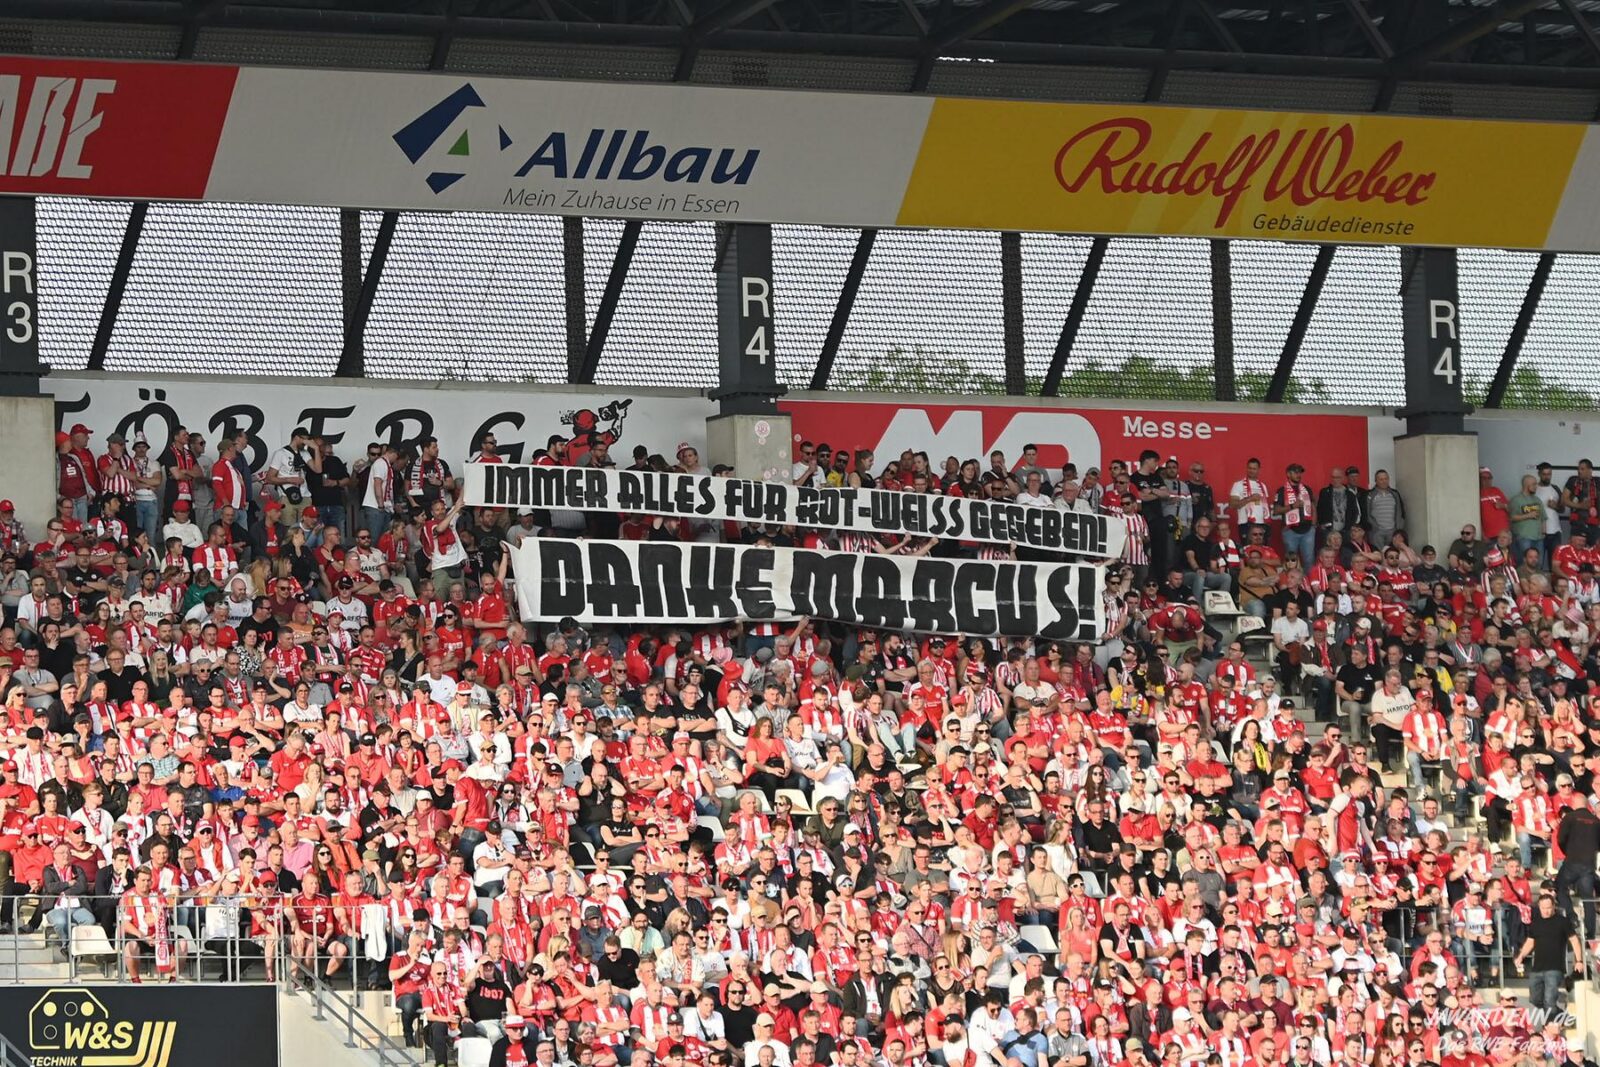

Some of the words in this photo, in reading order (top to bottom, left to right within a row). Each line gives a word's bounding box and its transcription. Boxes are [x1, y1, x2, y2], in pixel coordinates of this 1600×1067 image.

[513, 128, 760, 185] Allbau
[1054, 117, 1278, 229] Rudolf
[1263, 122, 1436, 206] Weber
[502, 188, 557, 207] Mein
[561, 190, 652, 210] Zuhause
[657, 193, 676, 211] in
[682, 196, 740, 214] Essen
[1252, 213, 1415, 236] Gebäudedienste
[2, 251, 33, 294] R
[741, 276, 770, 319] R
[6, 300, 33, 344] 3
[1429, 299, 1457, 340] R
[744, 326, 770, 365] 4
[1433, 346, 1458, 385] 4
[1123, 416, 1228, 439] Messe-
[485, 464, 608, 508] IMMER
[617, 472, 716, 515] ALLES
[796, 487, 964, 537] ROT-WEISS
[970, 500, 1108, 553] GEGEBEN!
[538, 541, 776, 620] DANKE
[790, 550, 1097, 640] MARCUS!
[65, 1021, 134, 1050] W&S
[30, 1056, 78, 1067] TECHNIK
